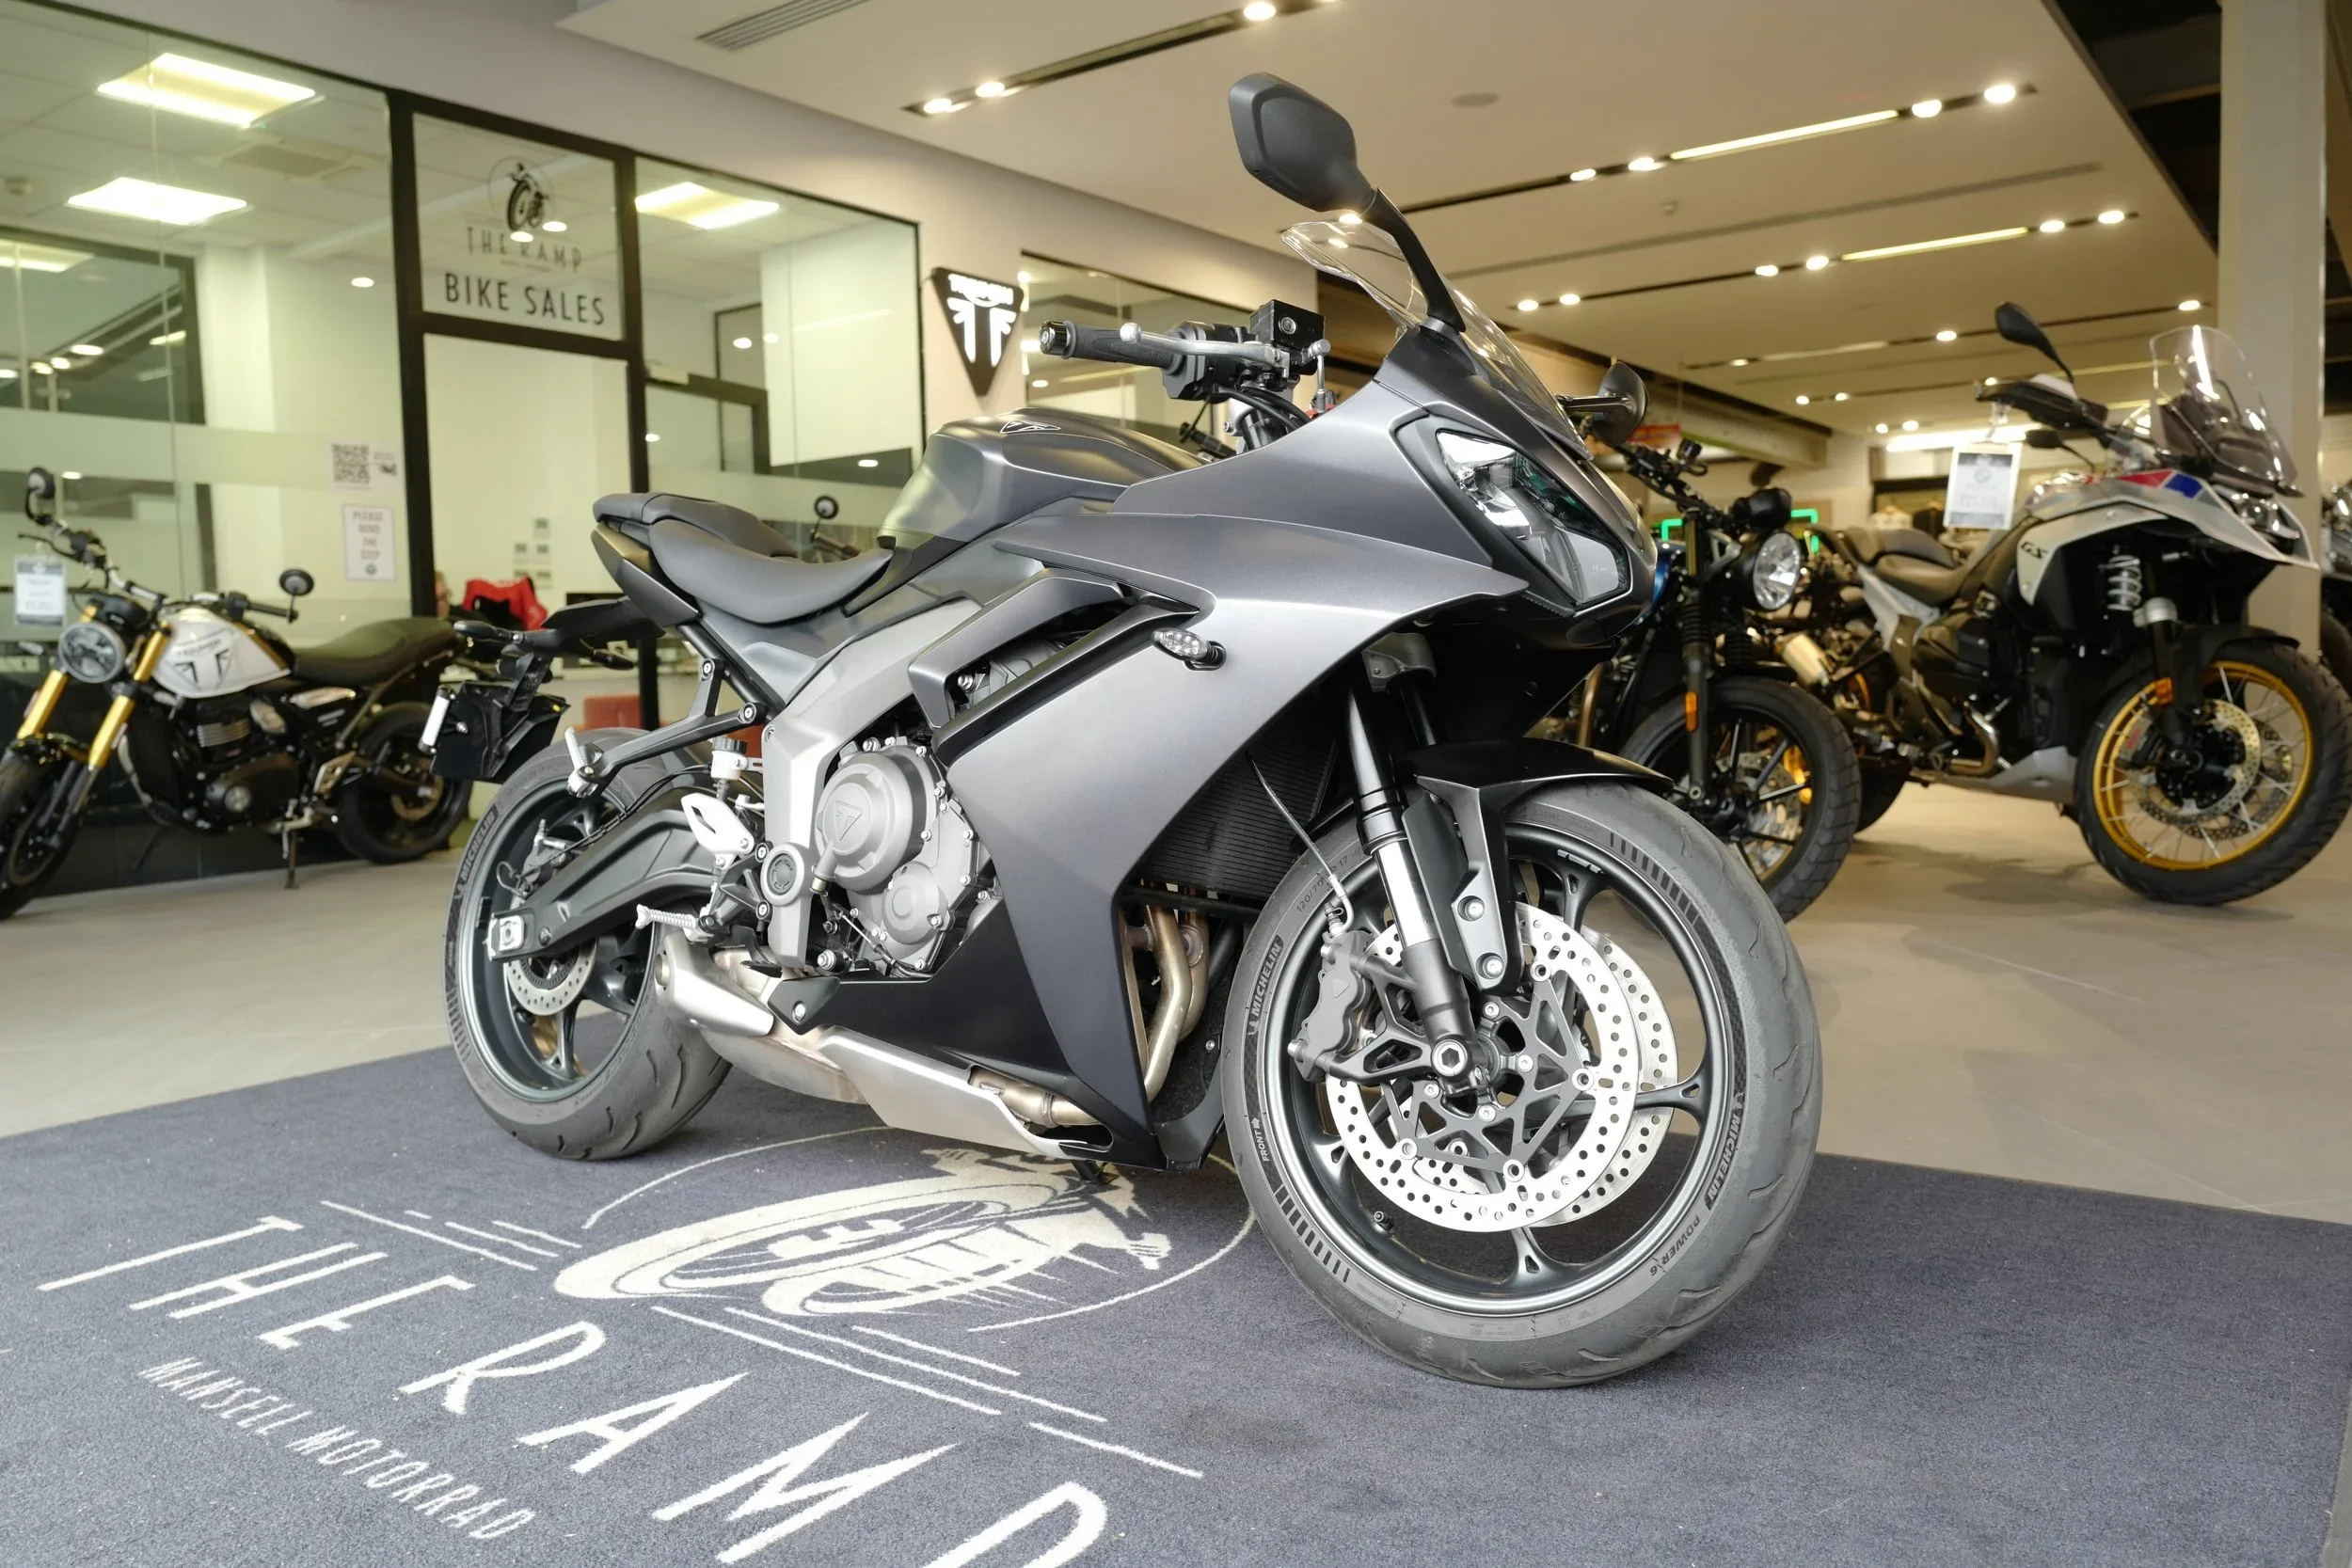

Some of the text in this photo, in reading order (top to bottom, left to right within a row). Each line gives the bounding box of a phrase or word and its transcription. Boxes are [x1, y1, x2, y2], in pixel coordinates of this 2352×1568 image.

[445, 272, 604, 325] BIKE SALES
[2021, 542, 2047, 560] GS
[461, 811, 496, 882] MICHELIN
[1251, 942, 1281, 1018] MICHELIN
[1254, 1130, 1270, 1162] FRONT
[1708, 1112, 1740, 1200] MICHELIN
[1649, 1214, 1701, 1277] POWER 6
[36, 1215, 475, 1349] THE
[139, 1356, 535, 1539] MANSELL MOTORRAD
